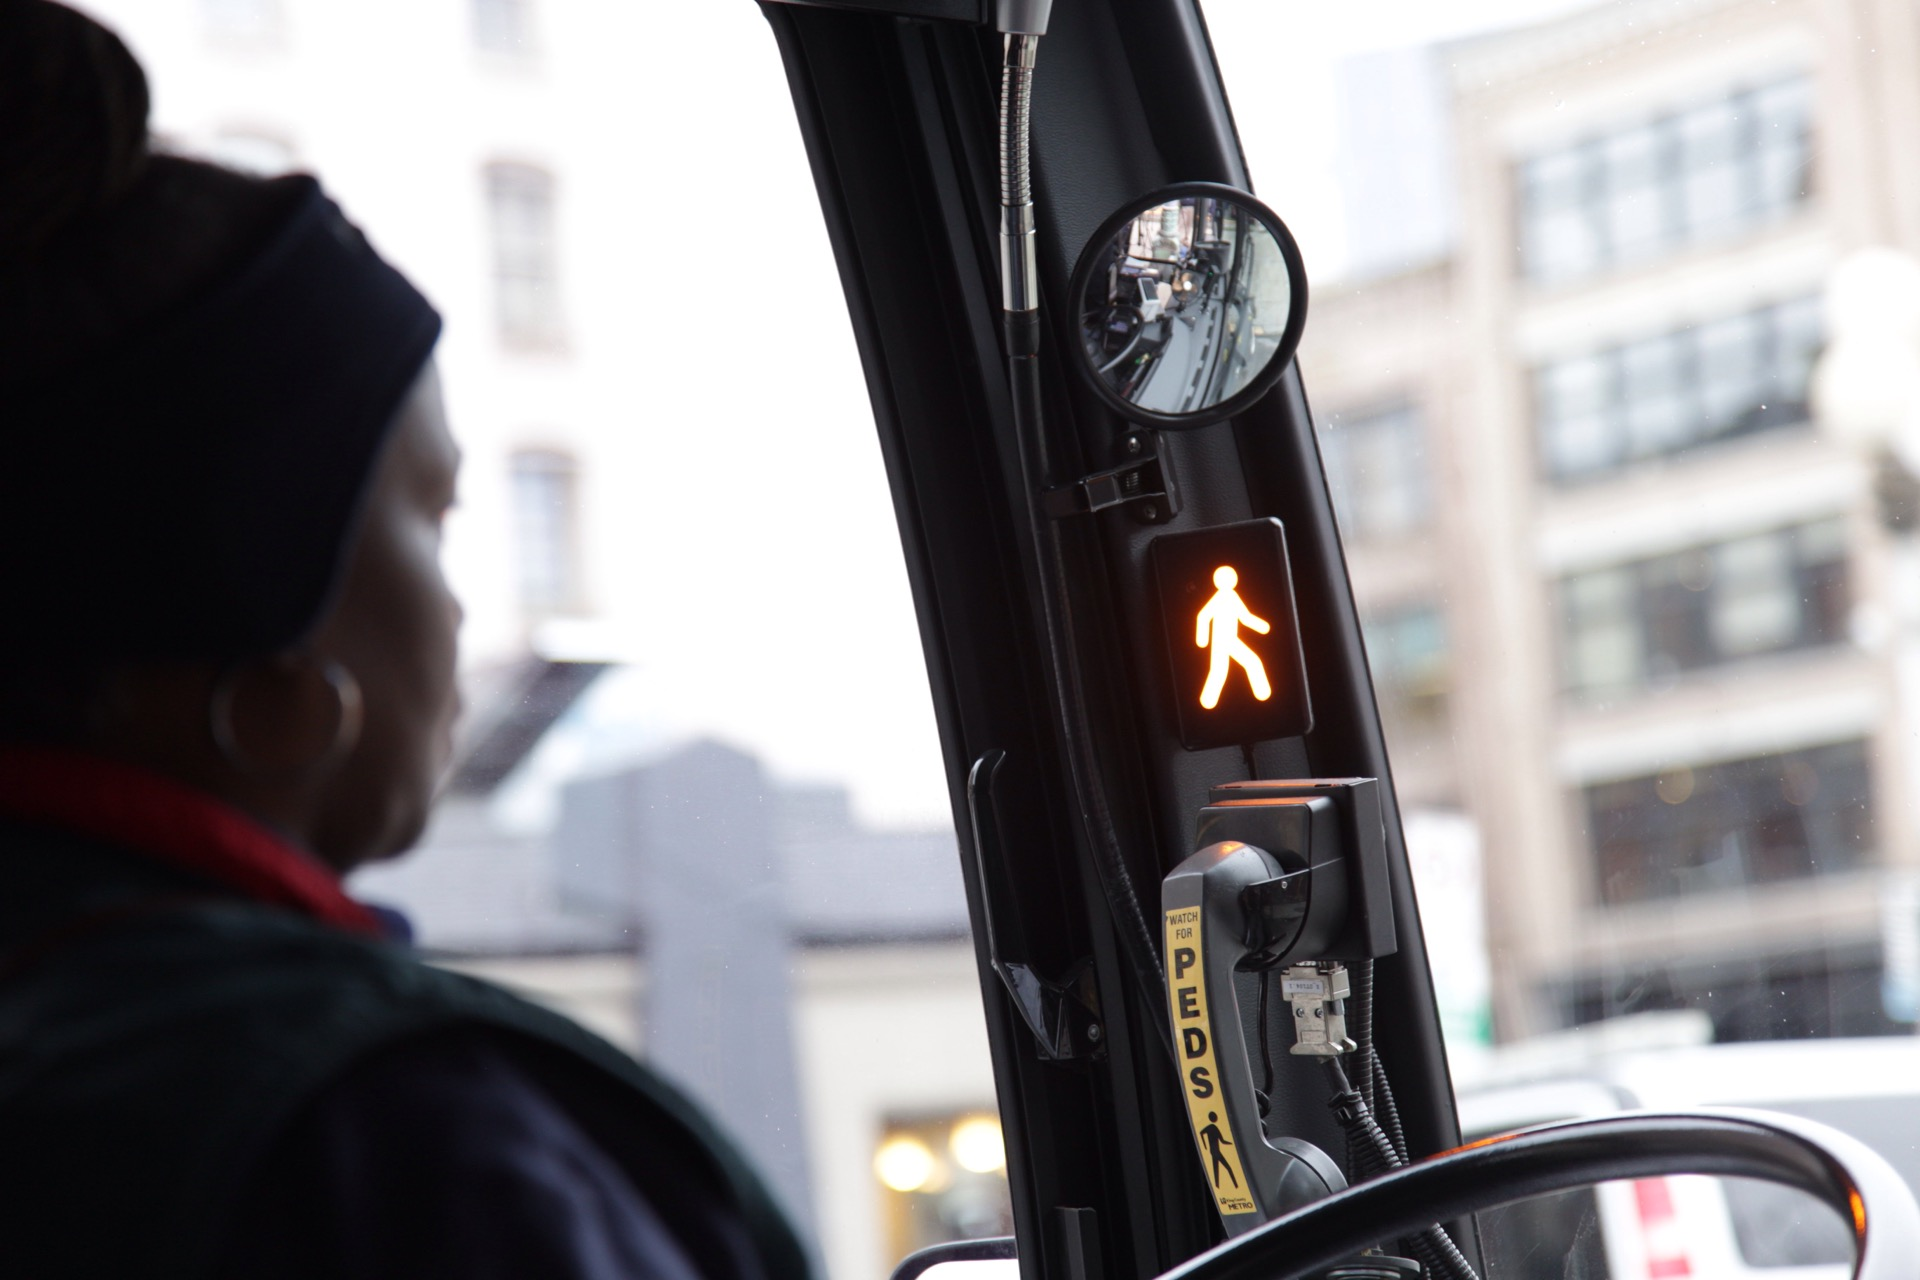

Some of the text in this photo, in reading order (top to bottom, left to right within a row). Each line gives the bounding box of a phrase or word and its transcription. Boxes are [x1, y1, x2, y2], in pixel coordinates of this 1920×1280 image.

[1170, 912, 1198, 926] WATCH
[1176, 928, 1192, 940] FOR
[1174, 947, 1214, 1098] PEDS
[1228, 1202, 1254, 1210] METRO
